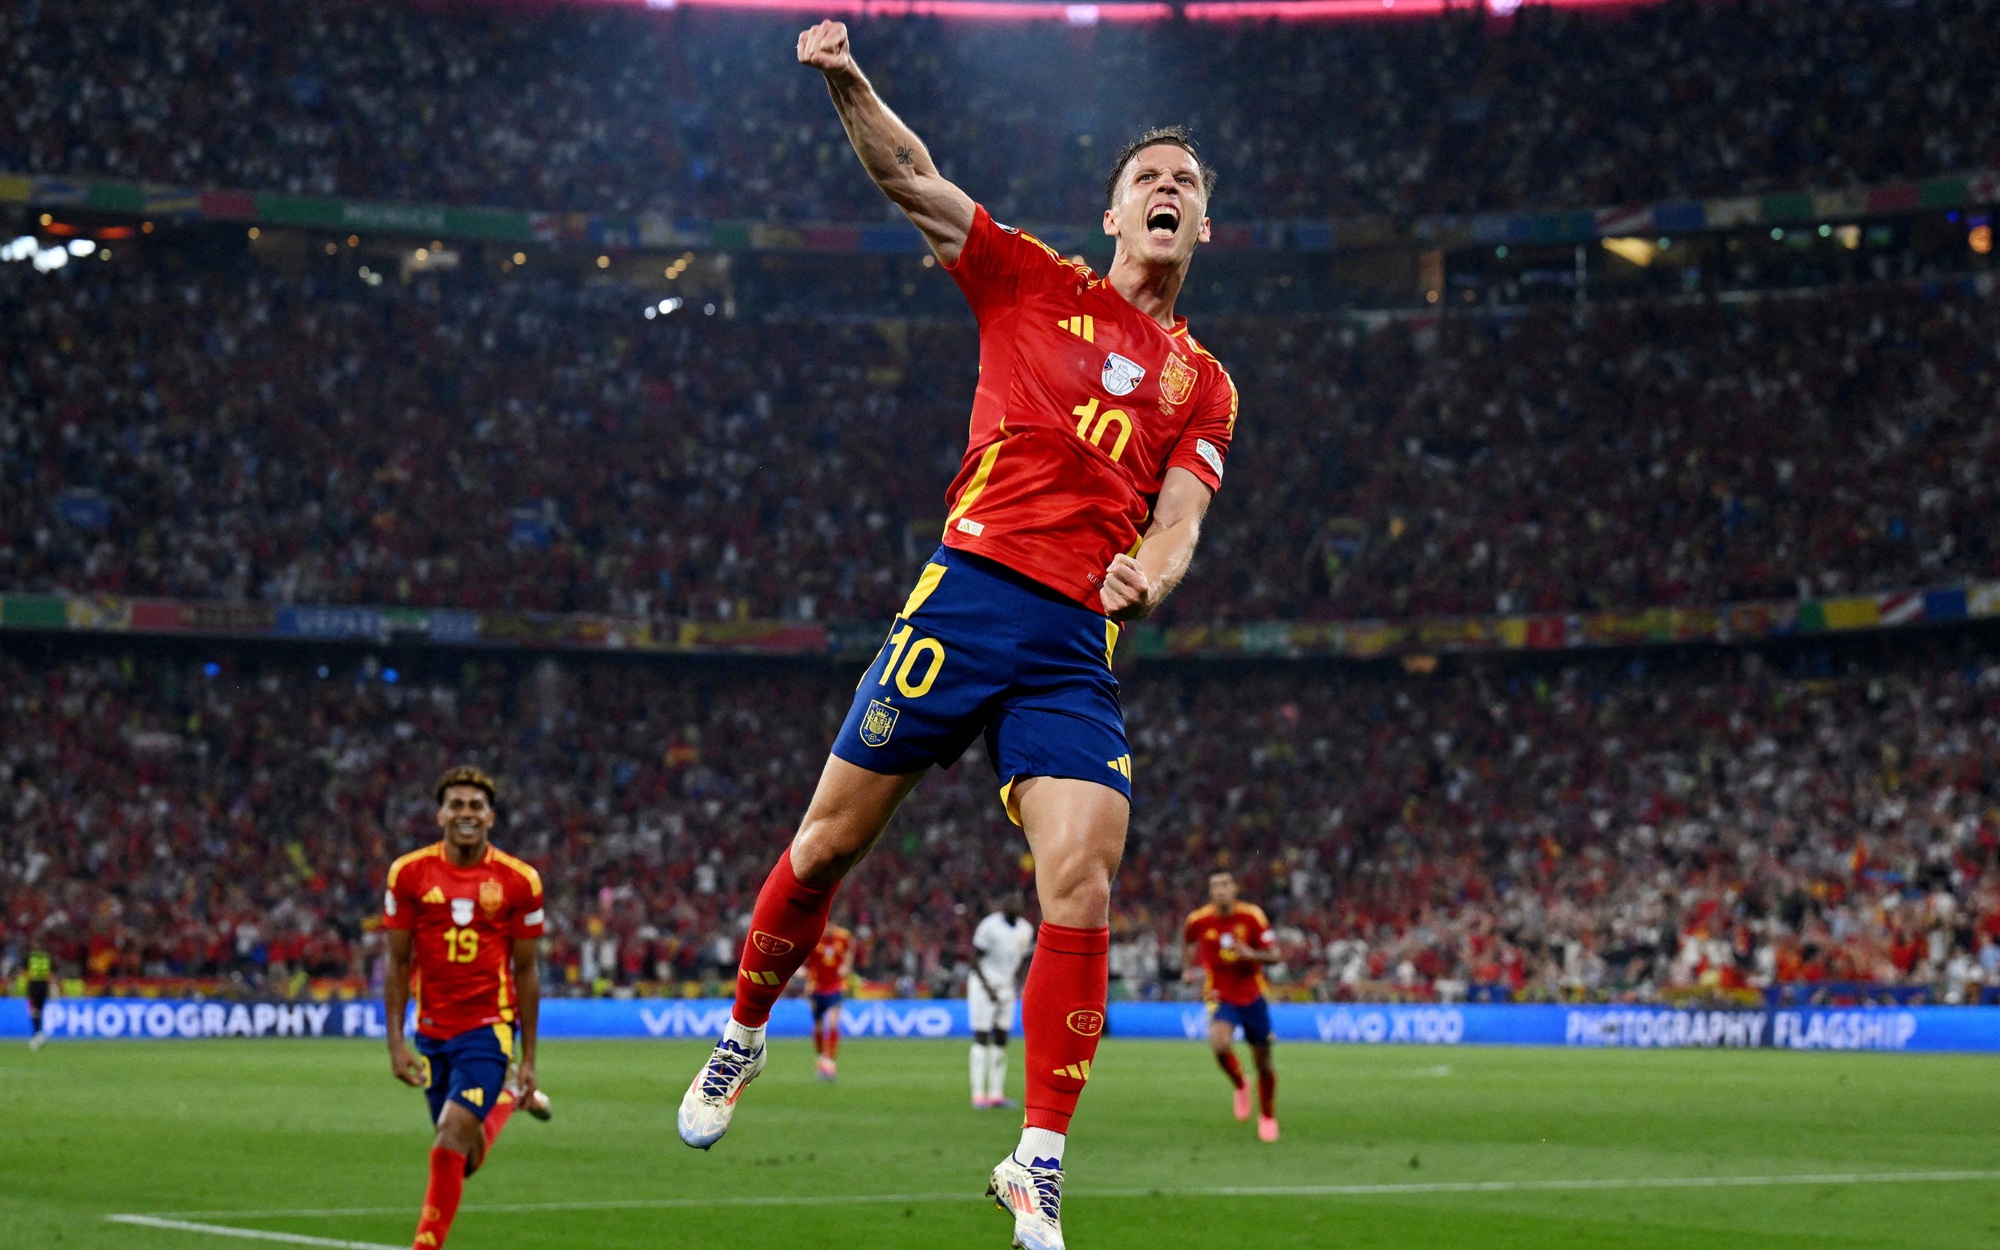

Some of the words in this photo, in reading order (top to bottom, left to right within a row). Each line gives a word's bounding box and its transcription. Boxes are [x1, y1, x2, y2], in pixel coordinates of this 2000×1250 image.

[1071, 397, 1132, 462] 10
[879, 624, 945, 698] 10
[443, 926, 479, 963] 19
[42, 1002, 331, 1037] PHOTOGRAPHY
[840, 1001, 952, 1036] vivo
[1315, 1006, 1387, 1042] vivo
[1389, 1009, 1464, 1043] X100
[1566, 1011, 1768, 1047] PHOTOGRAPHY
[1773, 1011, 1918, 1049] FLAGSHIP
